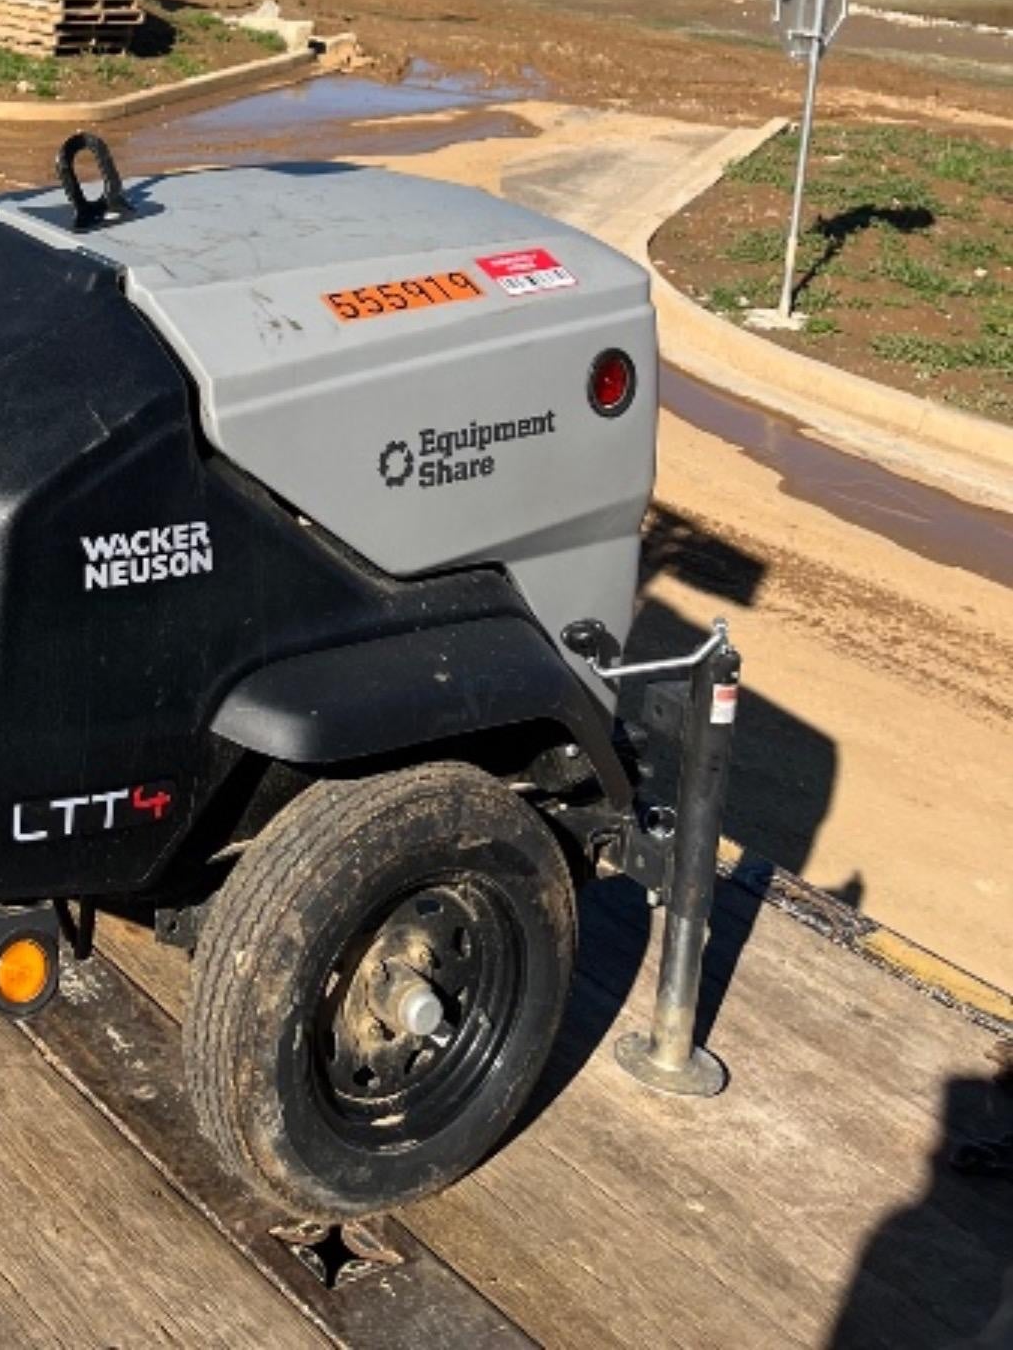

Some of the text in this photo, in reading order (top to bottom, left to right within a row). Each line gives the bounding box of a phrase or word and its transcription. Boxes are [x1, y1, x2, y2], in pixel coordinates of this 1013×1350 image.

[327, 271, 481, 319] 555919
[418, 409, 556, 458] Equipment
[418, 454, 495, 488] Share
[80, 521, 212, 563] WACKER
[84, 546, 214, 592] NEUSON
[12, 784, 171, 842] LTT4
